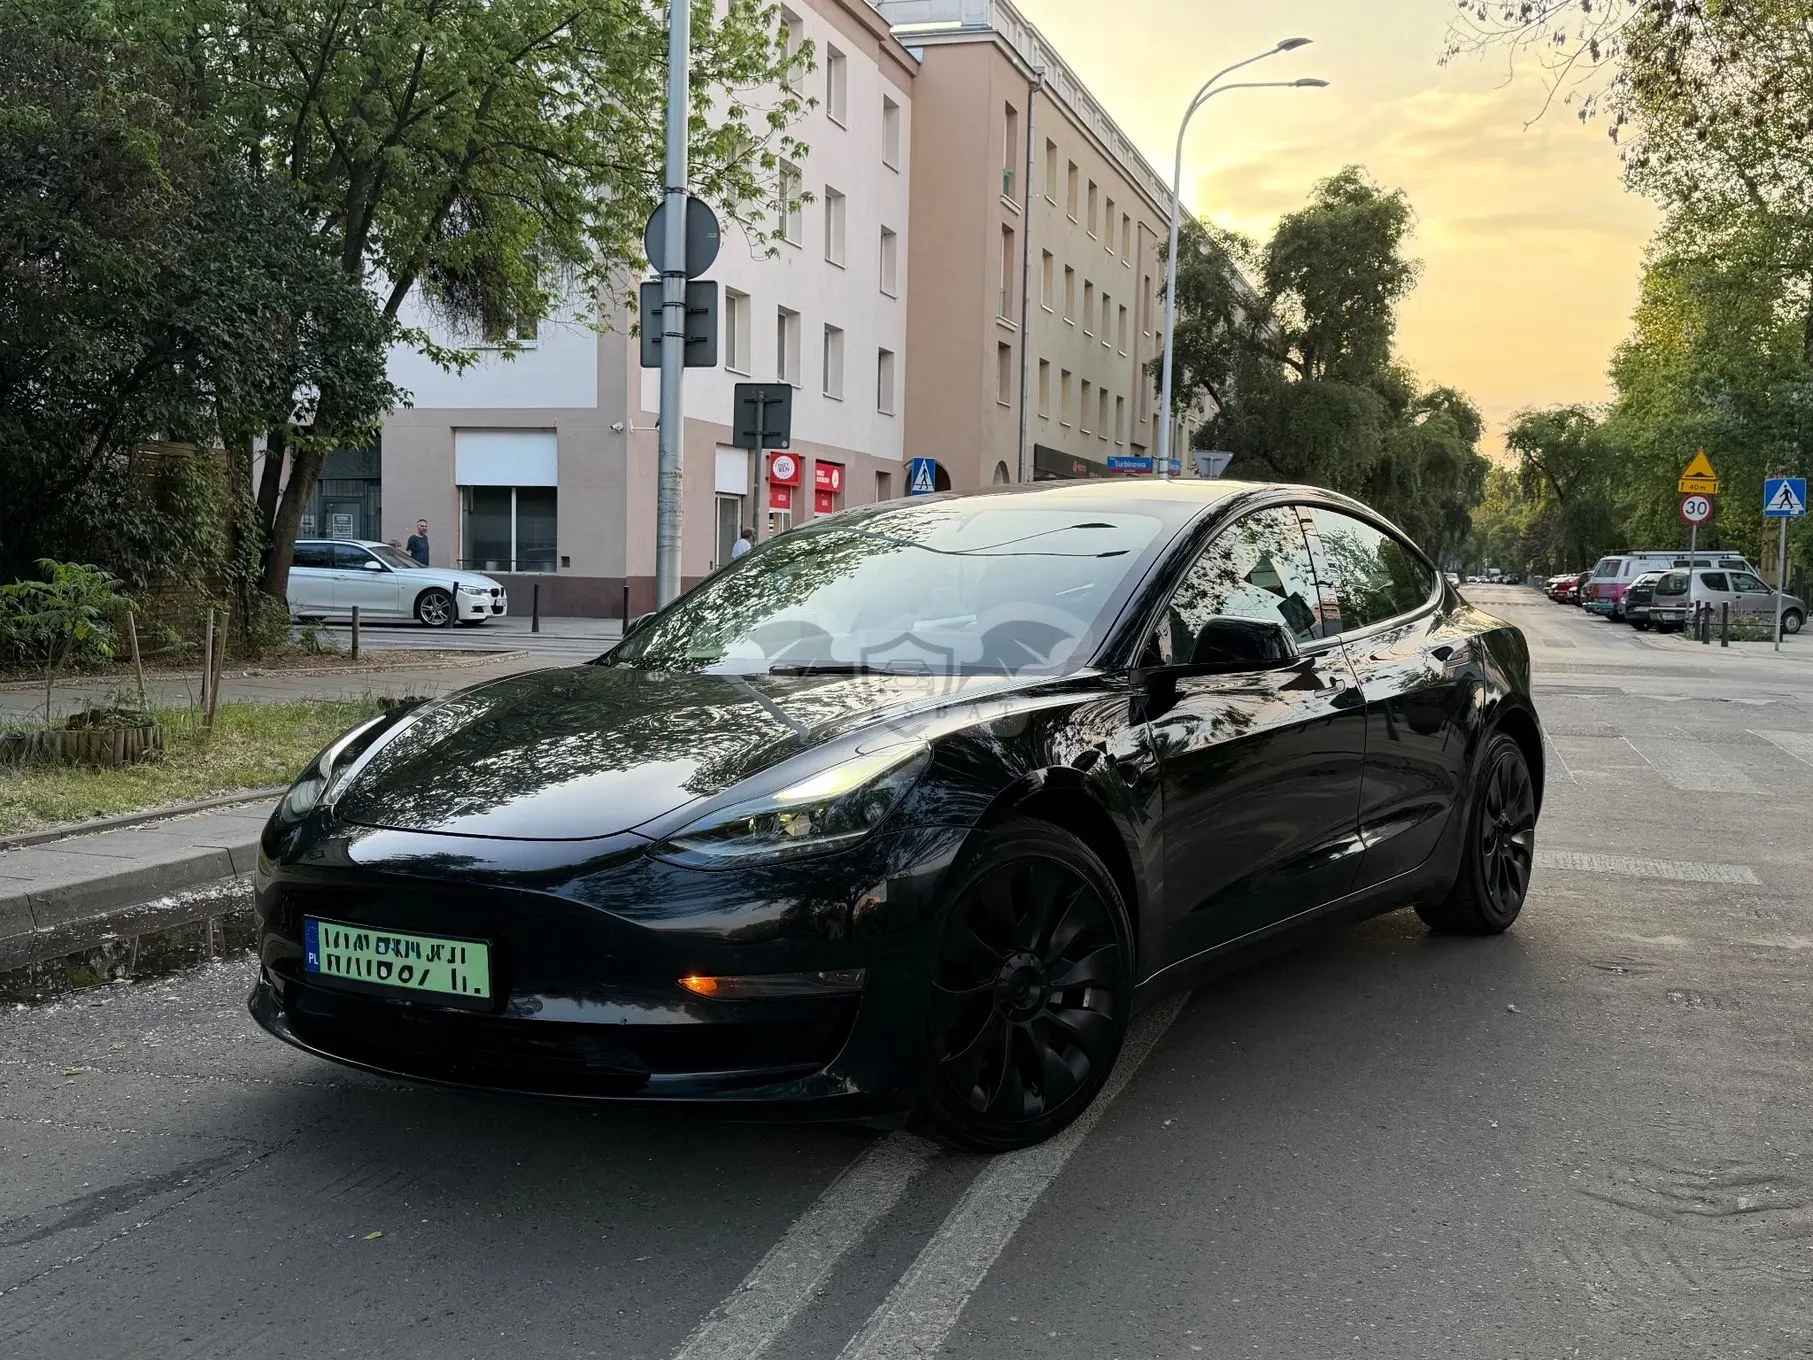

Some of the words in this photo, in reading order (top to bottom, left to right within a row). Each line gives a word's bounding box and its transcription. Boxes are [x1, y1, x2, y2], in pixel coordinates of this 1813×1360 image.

[1114, 459, 1146, 468] Turbinowa
[1685, 501, 1707, 515] 30
[308, 952, 319, 965] PL
